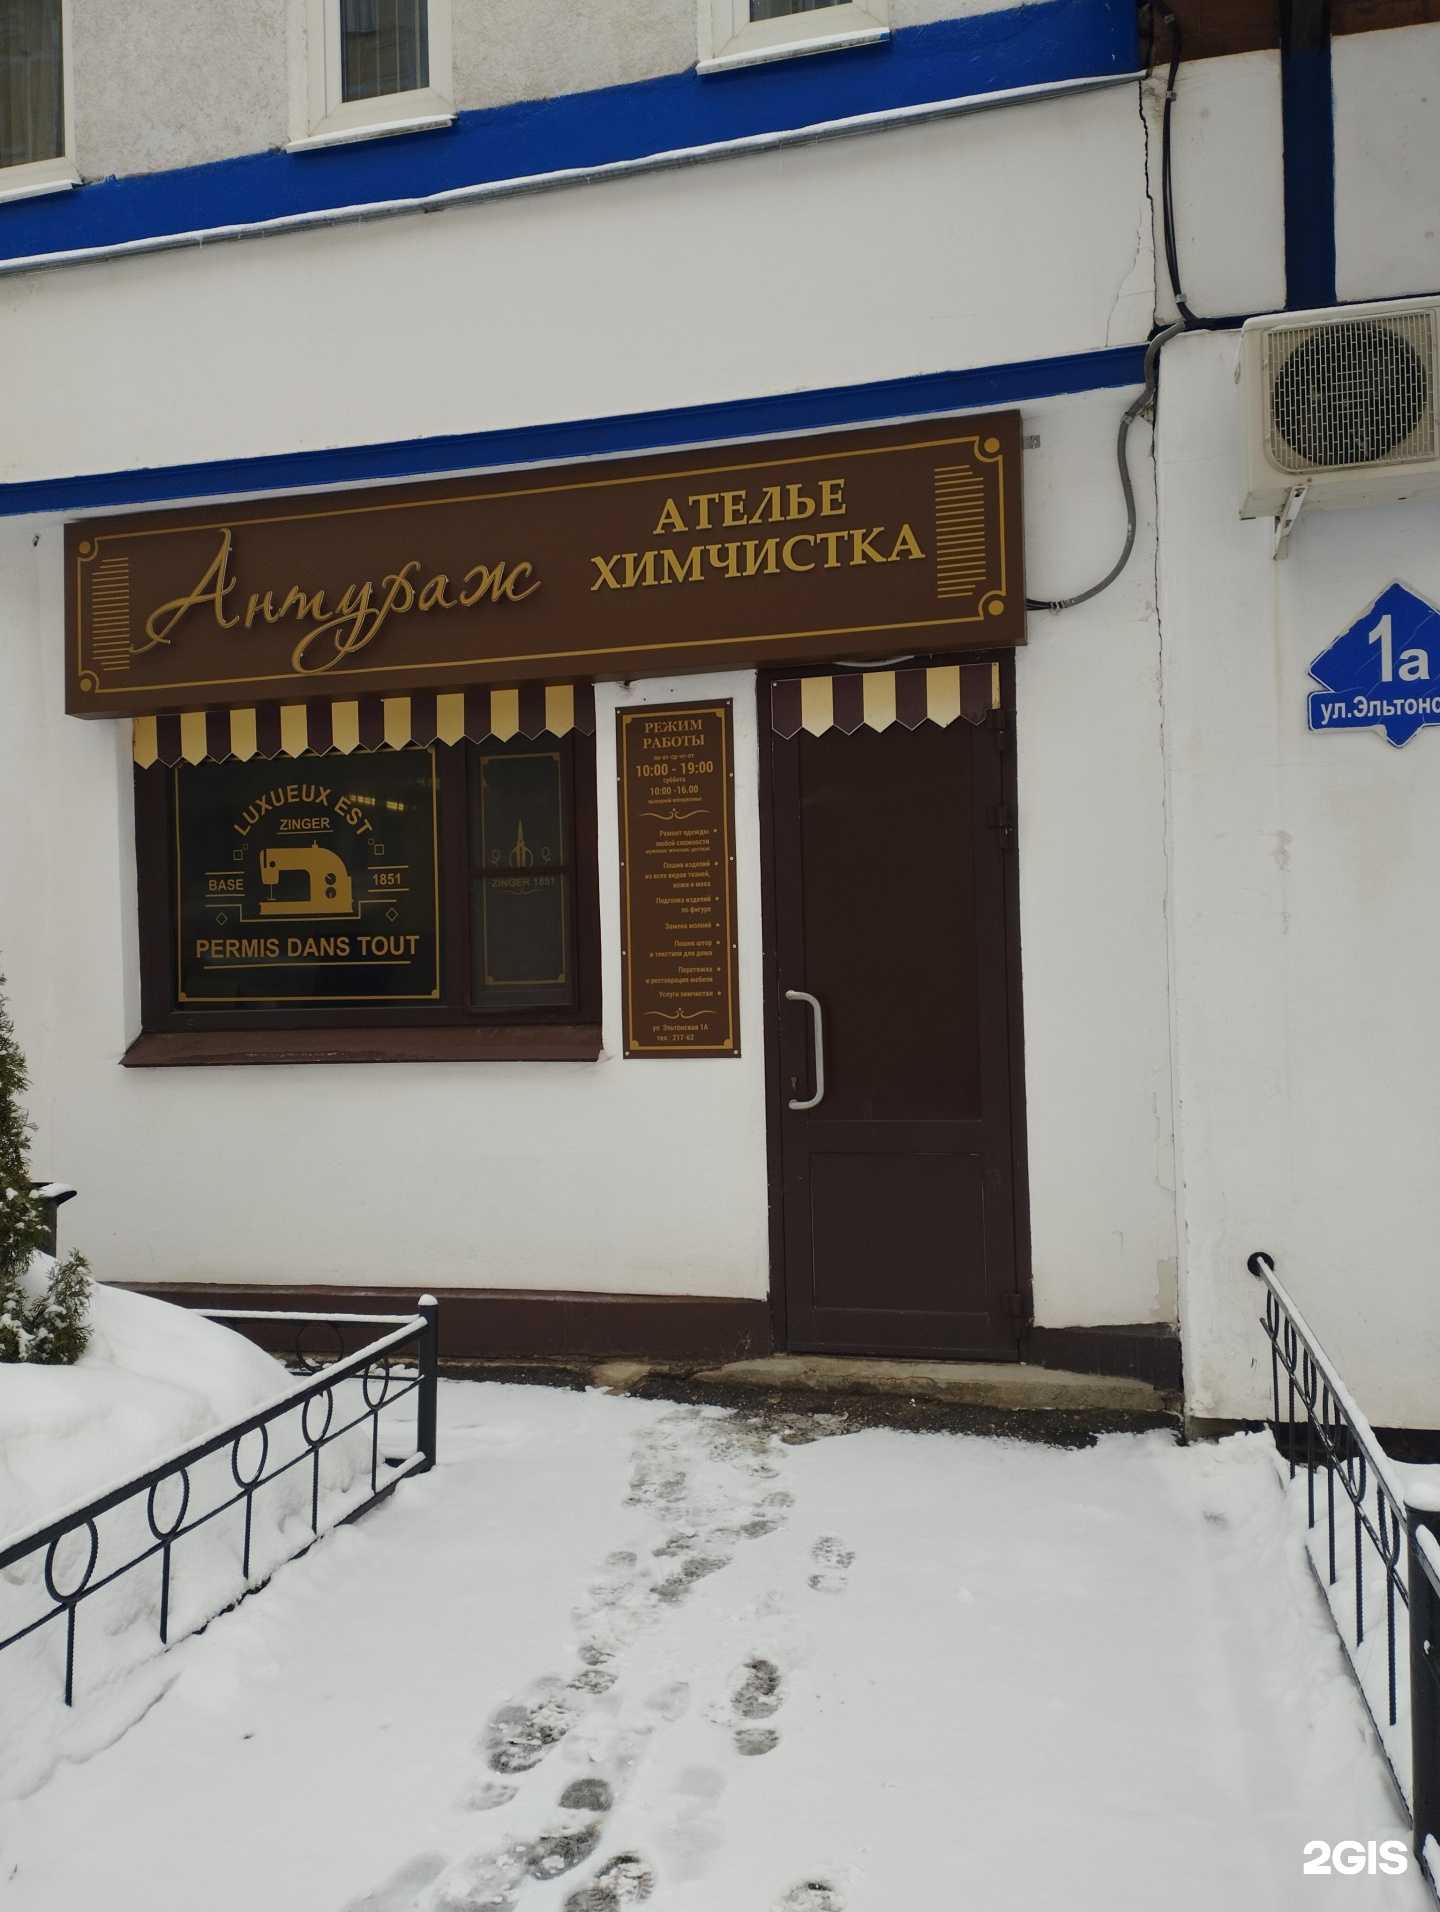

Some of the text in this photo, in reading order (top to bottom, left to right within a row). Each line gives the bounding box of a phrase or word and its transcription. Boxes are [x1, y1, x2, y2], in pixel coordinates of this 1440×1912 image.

[653, 478, 848, 537] АТЕЛЬЕ
[590, 523, 926, 593] ХИМЧИСТКА
[129, 528, 541, 675] Антураж
[1368, 614, 1431, 682] 1а
[644, 719, 703, 734] РЕЖИМ
[643, 734, 705, 749] РАБОТЫ
[636, 764, 669, 777] 10:00
[681, 761, 714, 774] 19:00
[650, 786, 672, 796] 10:00
[233, 784, 374, 837] LUXUEUX EST
[279, 817, 331, 832] ZINGER
[208, 878, 244, 892] BASE
[372, 872, 402, 887] 1851
[195, 935, 420, 959] PERMIS DANS TOUT
